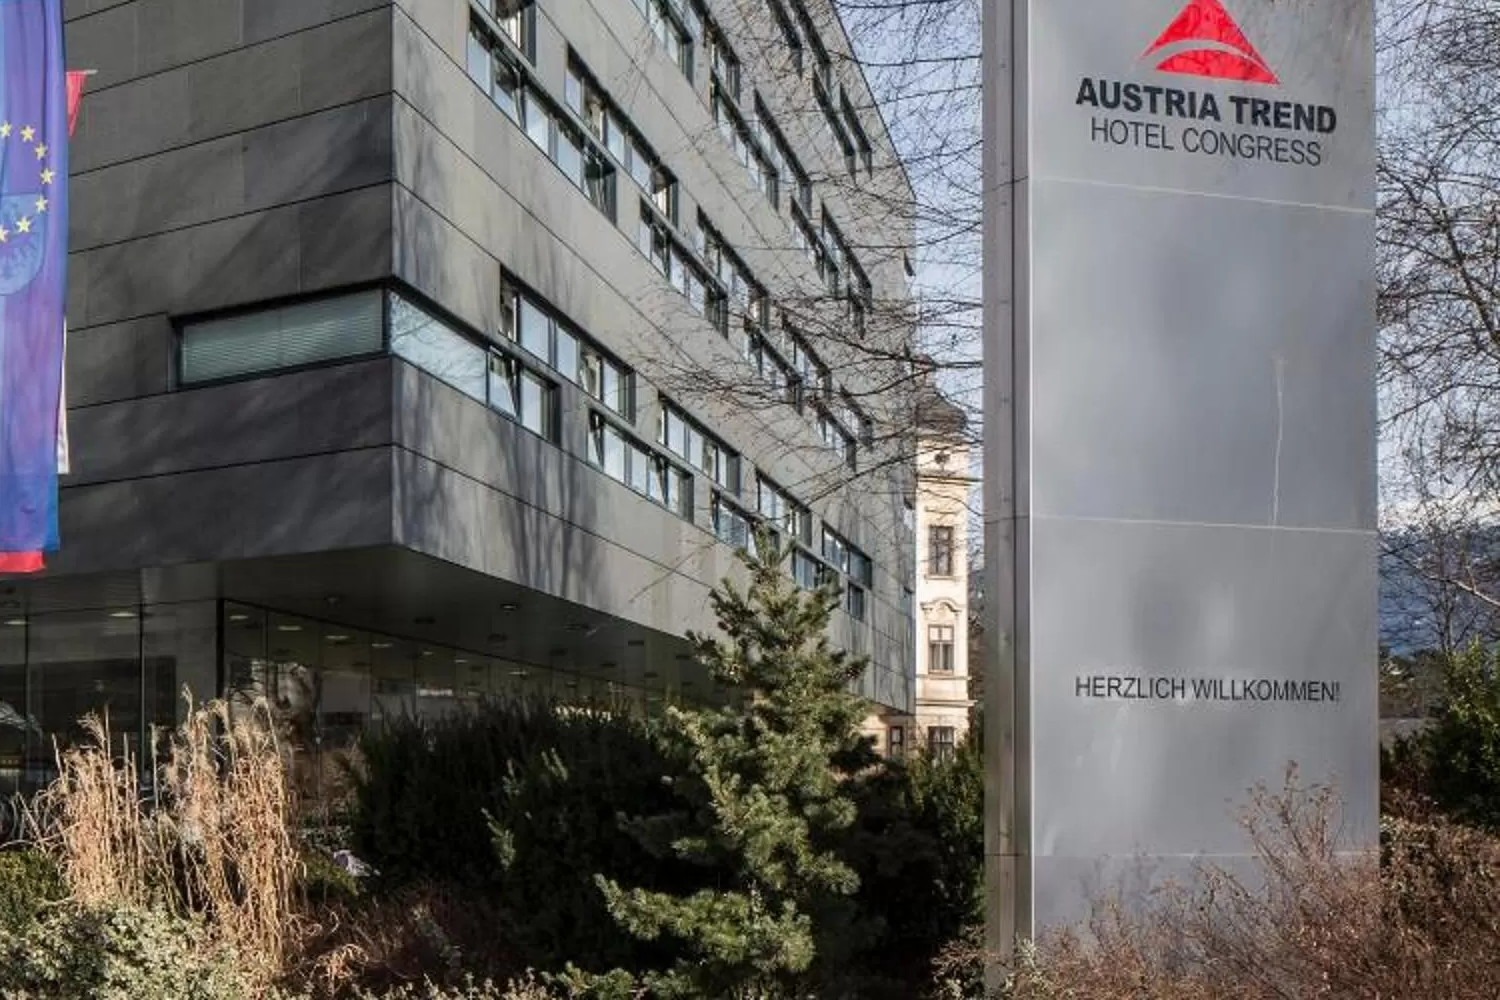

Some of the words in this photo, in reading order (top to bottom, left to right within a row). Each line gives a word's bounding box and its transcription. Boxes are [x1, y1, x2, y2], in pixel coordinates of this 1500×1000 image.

[1075, 77, 1221, 122] AUSTRIA
[1229, 95, 1337, 134] TREND
[1091, 117, 1175, 151] HOTEL
[1181, 127, 1322, 167] CONGRESS
[1075, 675, 1185, 699] HERZLICH
[1191, 678, 1341, 702] WILLKOMMEN!
